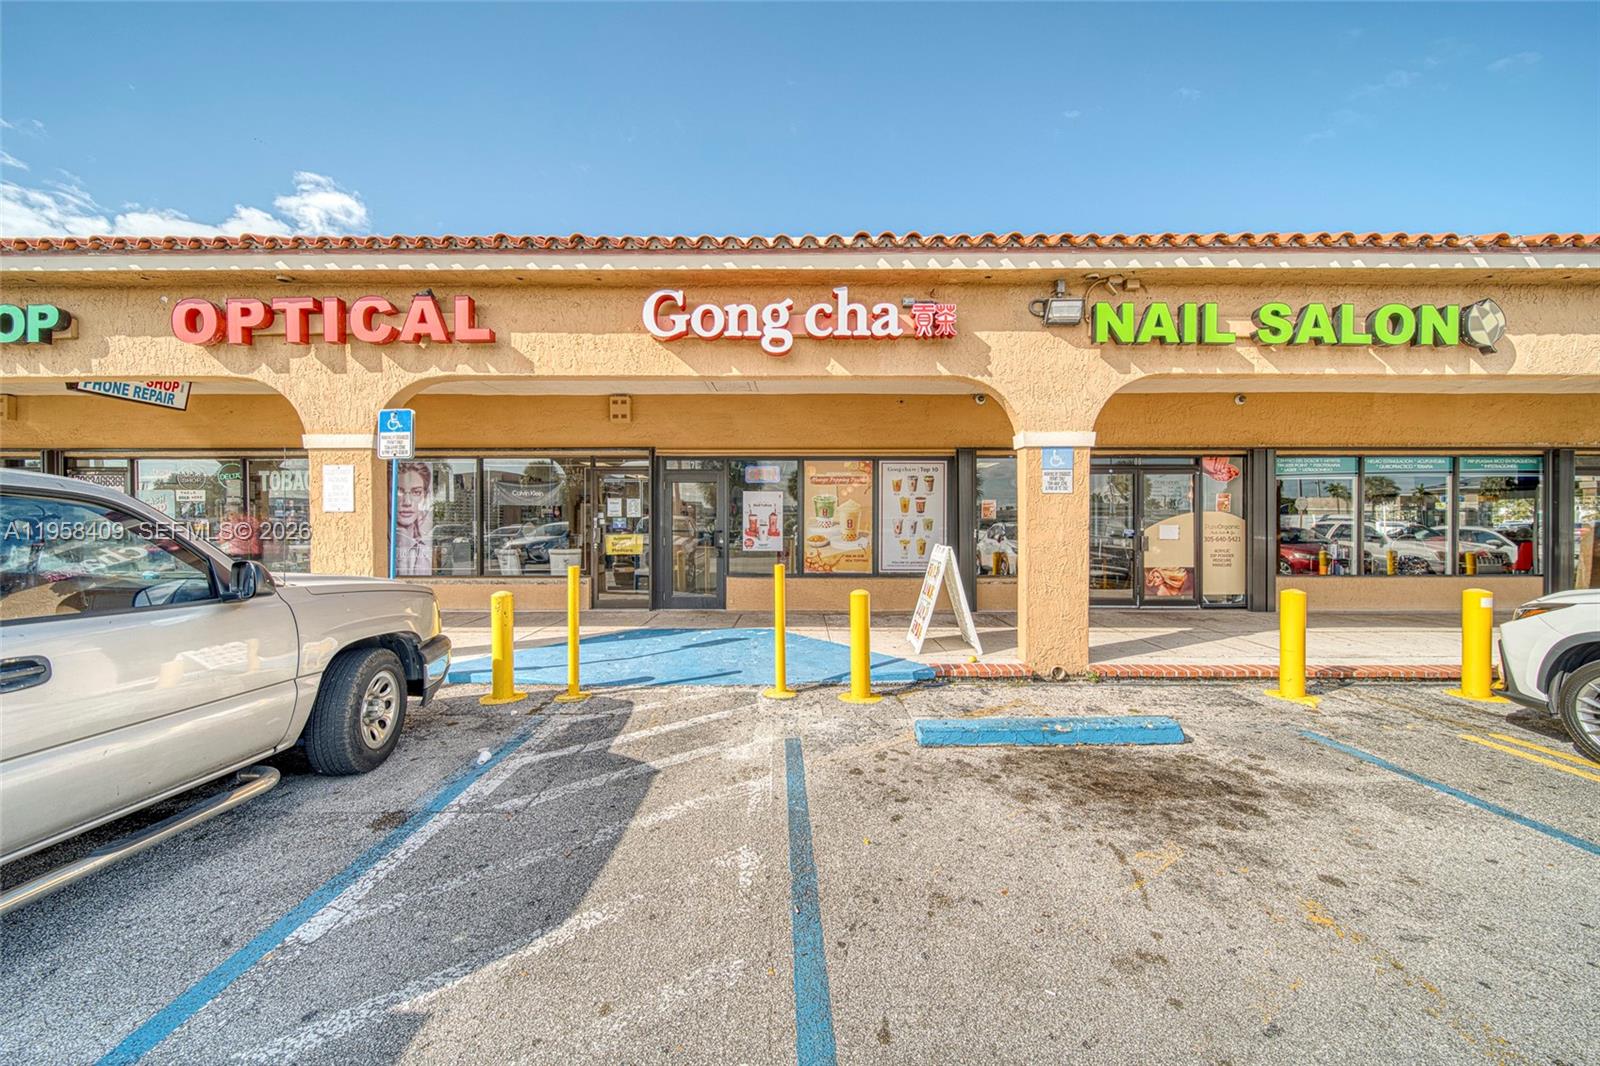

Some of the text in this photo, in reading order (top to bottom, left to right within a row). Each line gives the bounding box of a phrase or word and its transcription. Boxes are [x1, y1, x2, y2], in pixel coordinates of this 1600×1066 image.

[171, 294, 496, 345] OPTICAL
[642, 287, 903, 354] Gong cha
[1093, 302, 1460, 346] NAIL SALON
[133, 385, 176, 405] REPAIR
